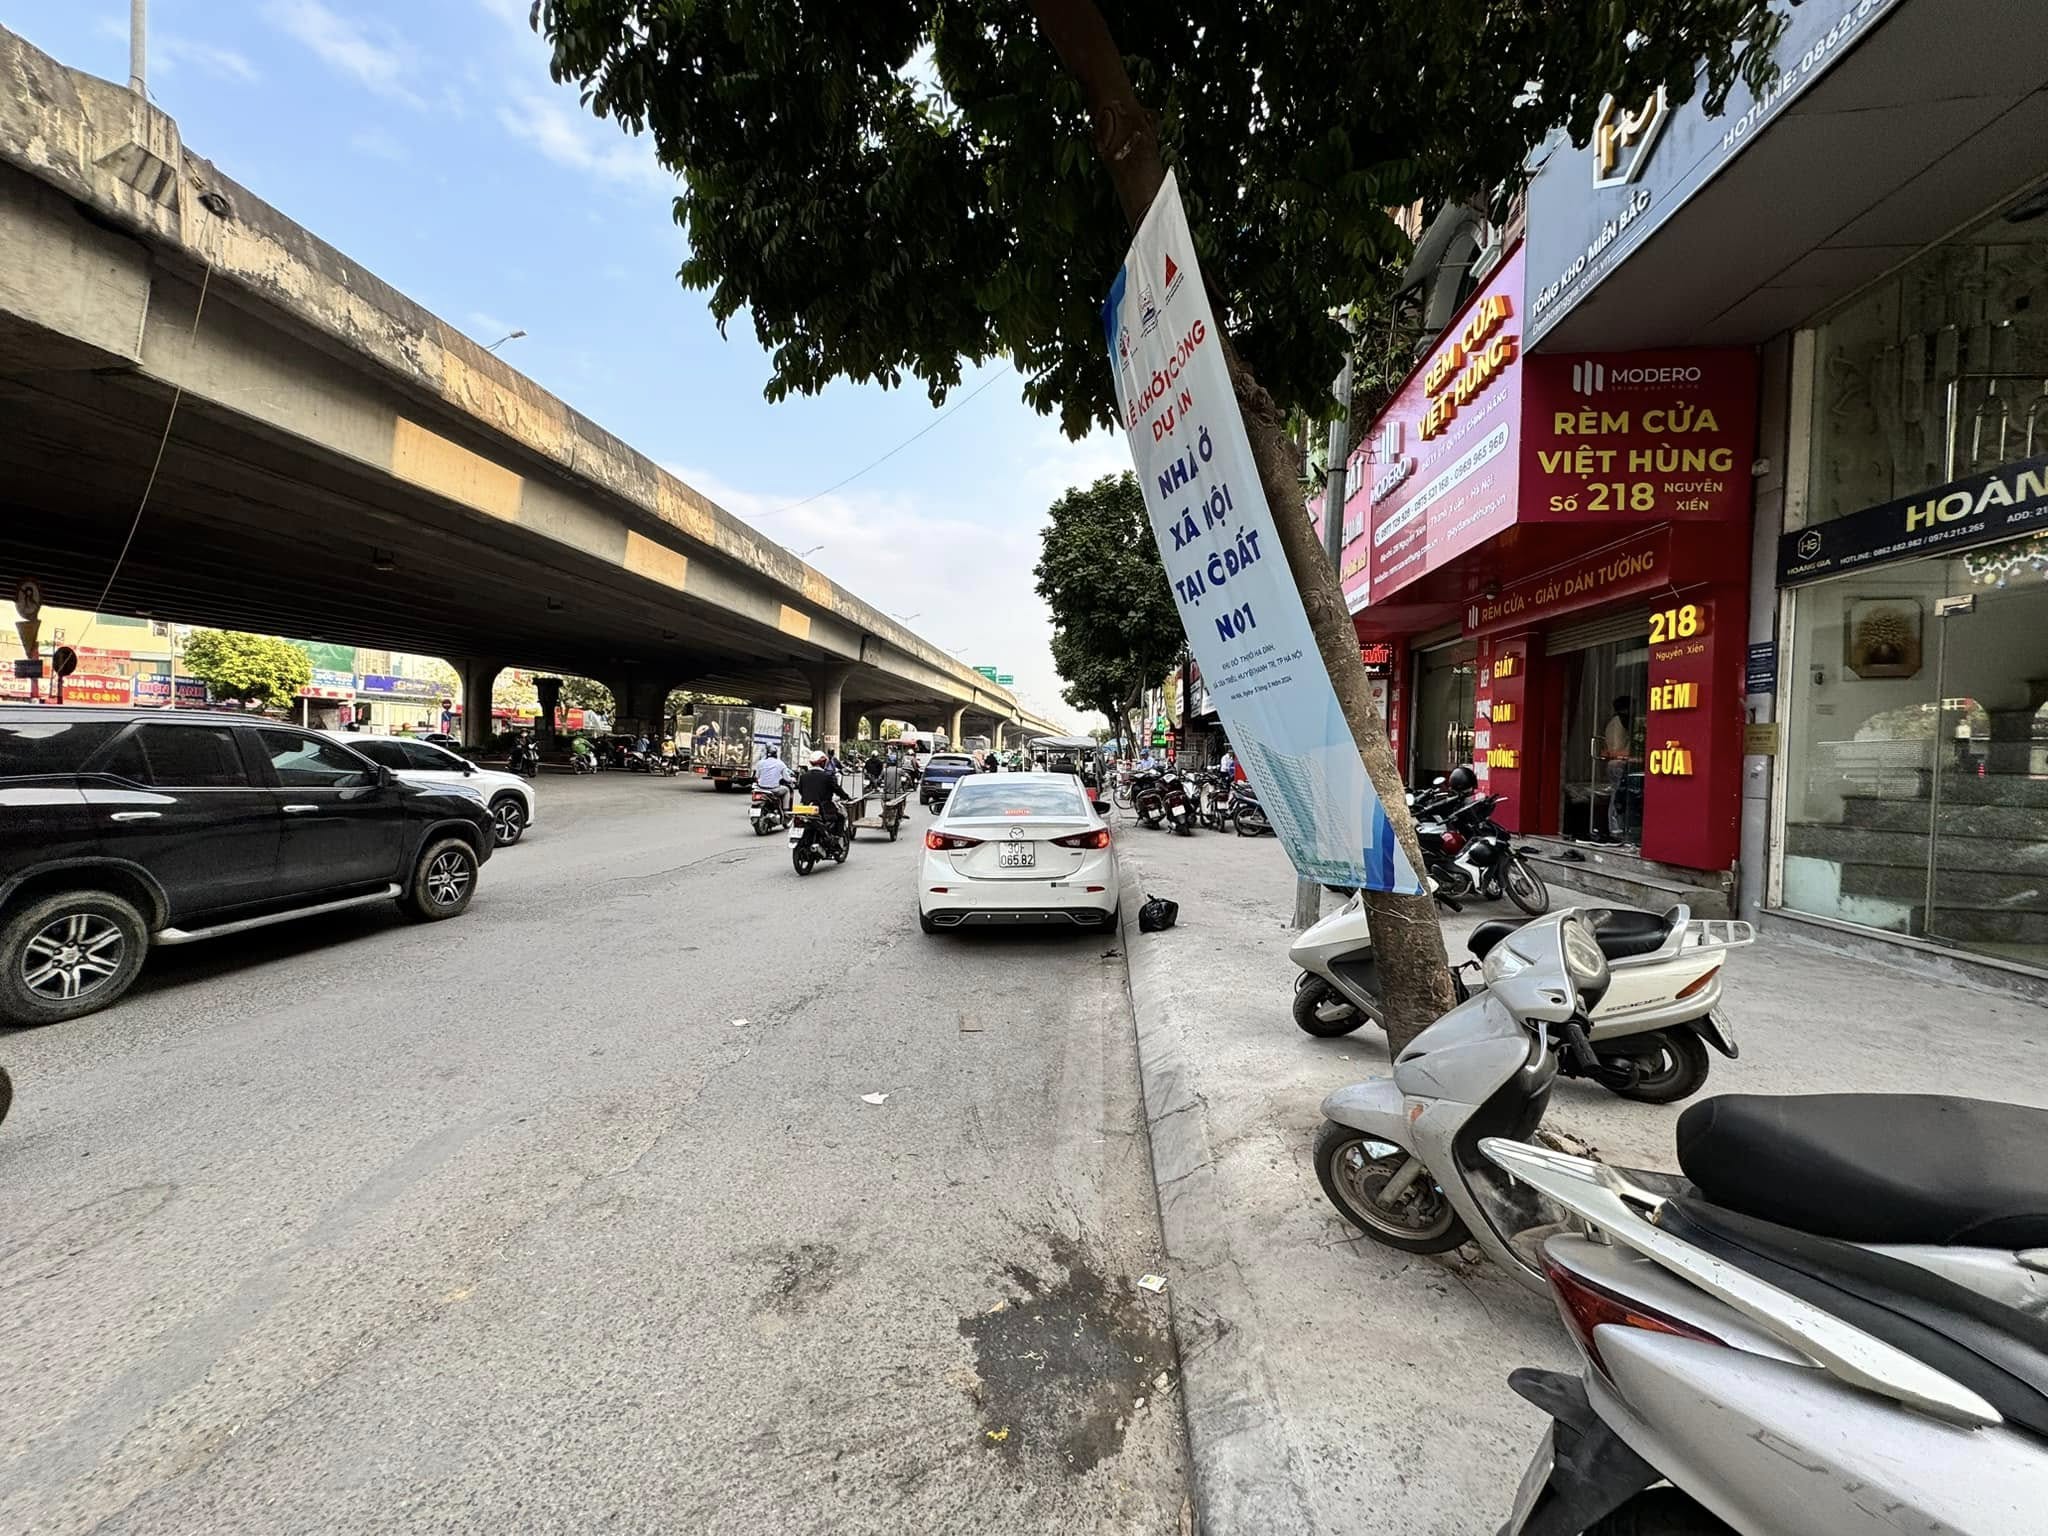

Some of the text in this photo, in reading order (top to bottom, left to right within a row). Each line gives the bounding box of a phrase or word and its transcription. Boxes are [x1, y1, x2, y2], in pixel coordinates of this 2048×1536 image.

[1532, 190, 1650, 317] TỔNG KHO MIỀN BẮC
[1424, 296, 1503, 398] RÈM CỬA
[1138, 369, 1172, 417] KHỞI
[1169, 319, 1206, 378] CÔNG
[1611, 366, 1702, 383] MODERO
[1417, 336, 1508, 441] VIỆT HÙNG
[1152, 387, 1193, 442] DỰ ÁN
[1554, 400, 1720, 435] RÈM CỬA
[1198, 424, 1213, 463] Ở
[1488, 432, 1504, 453] 968
[1537, 443, 1733, 480] VIỆT HÙNG
[1550, 478, 1723, 512] Số 218 NGUYỄN
[1169, 507, 1201, 552] XÃ
[2007, 510, 2034, 523] ADD:
[1175, 525, 1262, 607] TẠI Ô ĐẤT
[1840, 551, 1873, 565] HOTLINE:
[1482, 602, 1500, 623] RÈM
[1503, 592, 1524, 615] CỬA
[1564, 570, 1594, 596] DÁN
[1598, 551, 1654, 585] TƯỜNG
[1649, 604, 1698, 644] 218
[1493, 700, 1512, 723] DÁN
[1650, 679, 1693, 711] RÈM
[1650, 740, 1689, 776] CỬA
